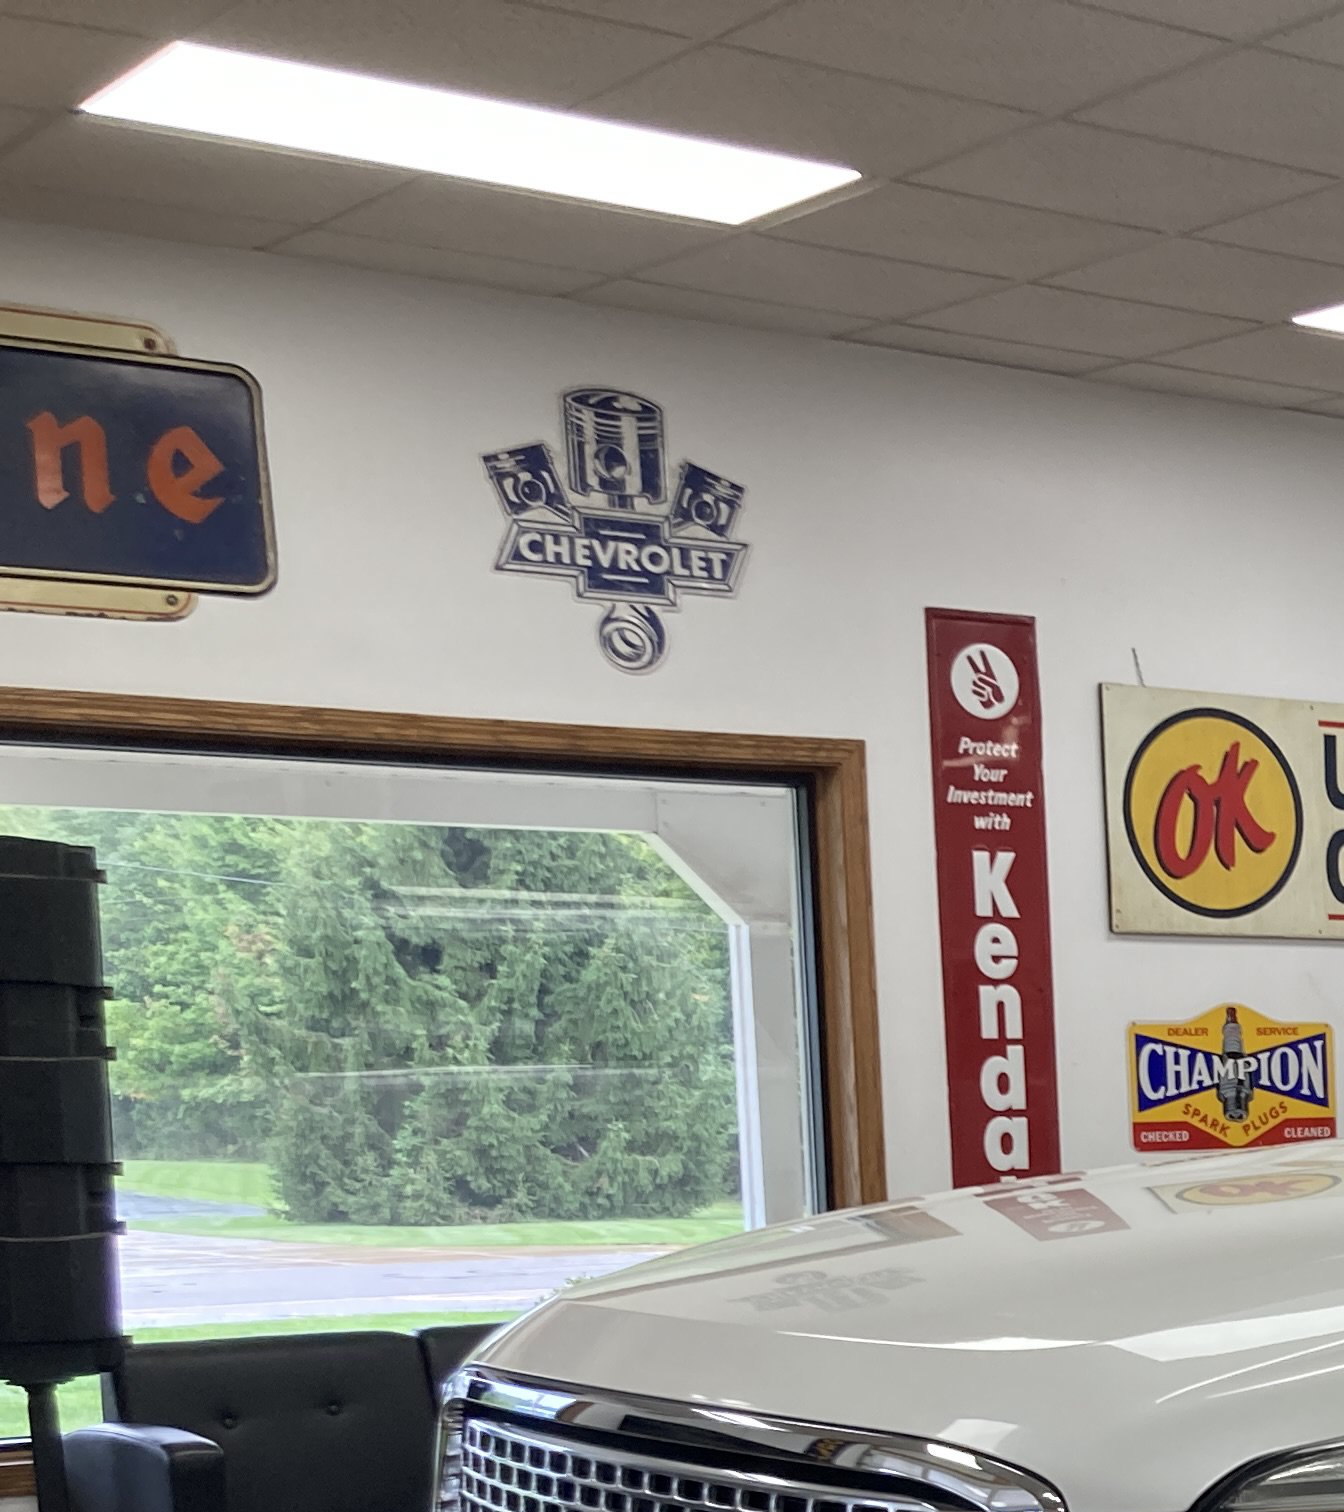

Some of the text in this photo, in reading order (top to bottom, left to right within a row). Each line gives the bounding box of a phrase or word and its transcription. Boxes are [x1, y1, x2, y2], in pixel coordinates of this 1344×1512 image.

[517, 531, 729, 581] CHEVROLET
[958, 736, 1019, 758] Protect
[973, 763, 1008, 782] Your
[946, 785, 1034, 807] Investment
[973, 812, 1011, 830] with
[1153, 741, 1277, 880] OK
[971, 849, 1030, 1183] Kenda
[1167, 1027, 1300, 1037] DEALER SERVICE
[1138, 1039, 1325, 1101] CHAMPION
[1181, 1101, 1288, 1138] SPARK PLUGS
[1140, 1130, 1190, 1143] CHECKED
[1283, 1126, 1331, 1138] CLEANED
